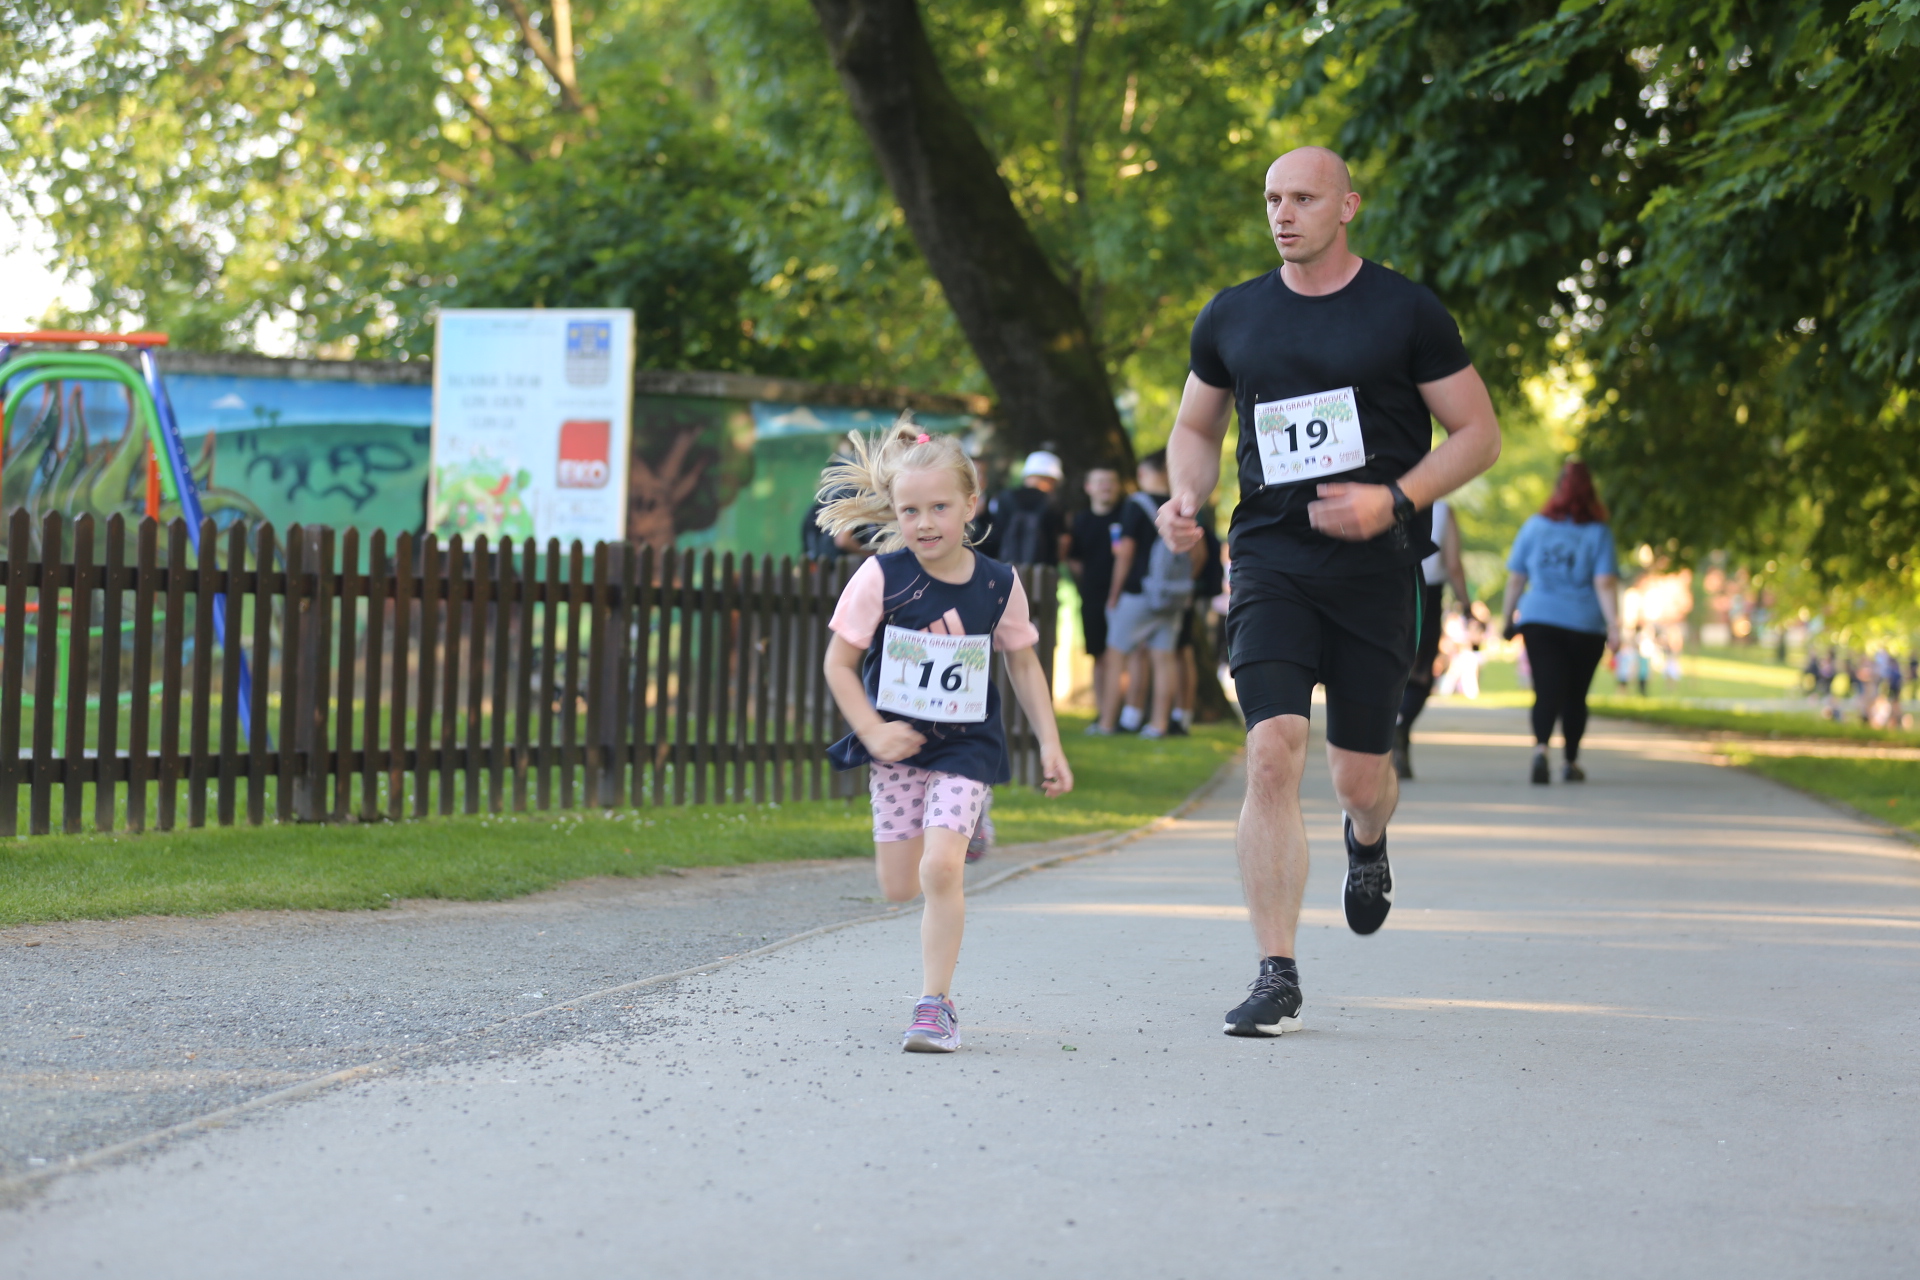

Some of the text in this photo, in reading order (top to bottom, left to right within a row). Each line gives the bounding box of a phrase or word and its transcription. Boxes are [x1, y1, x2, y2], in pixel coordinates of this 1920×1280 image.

[1286, 401, 1313, 412] GRADA
[1314, 392, 1349, 406] ČAKOVCA
[1284, 419, 1328, 453] 19
[929, 638, 957, 650] GRADA
[918, 660, 963, 692] 16
